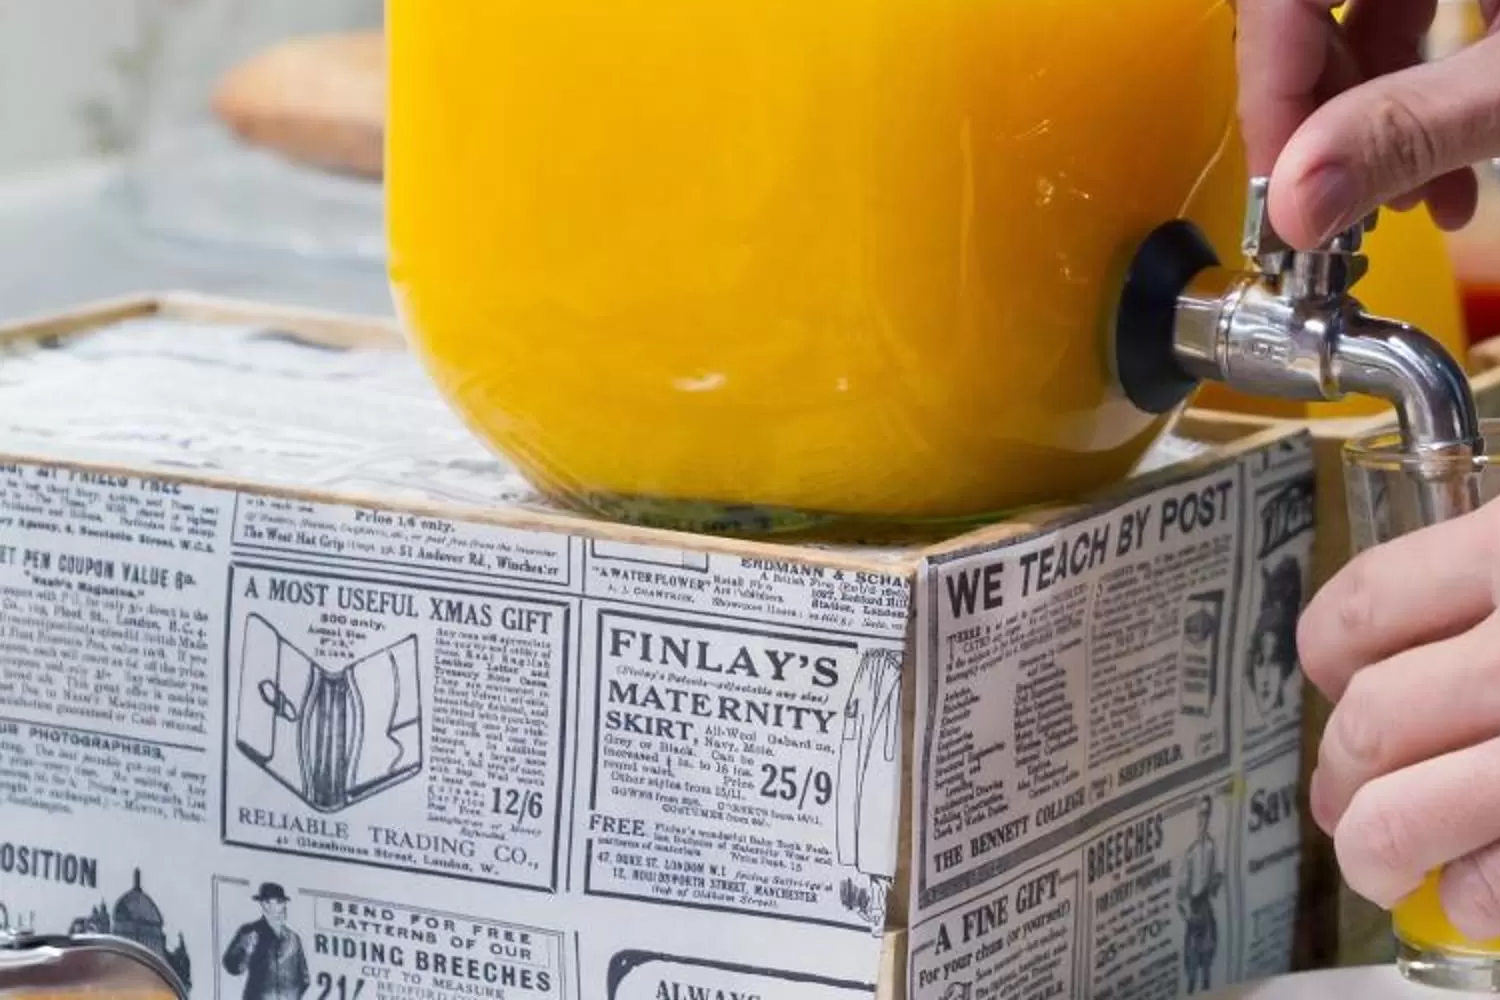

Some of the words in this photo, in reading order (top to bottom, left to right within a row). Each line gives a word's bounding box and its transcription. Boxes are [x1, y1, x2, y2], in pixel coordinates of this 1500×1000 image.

[356, 510, 393, 526] Price
[244, 524, 264, 541] The
[266, 527, 293, 544] West
[296, 531, 317, 547] Hat
[319, 534, 345, 554] Grip
[418, 546, 465, 565] Andover
[946, 562, 1004, 619] WE
[1019, 523, 1111, 597] TEACH
[1116, 504, 1152, 556] BY
[1159, 480, 1233, 541] POST
[24, 547, 51, 571] PEN
[58, 553, 115, 580] COUPON
[121, 562, 168, 588] VALUE
[610, 567, 653, 584] WATER
[741, 555, 825, 579] ERDMANN
[833, 569, 845, 582] &
[244, 574, 260, 600] A
[268, 576, 331, 609] MOST
[337, 585, 420, 620] USEFUL
[428, 596, 493, 629] XMAS
[501, 605, 553, 637] GIFT
[608, 627, 839, 690] FINLAY'S
[608, 679, 837, 735] MATERNITY
[29, 725, 165, 761] PHOTOGRAPHERS,
[604, 709, 699, 746] SKIRT,
[604, 732, 632, 749] Grey
[711, 749, 735, 763] Can
[704, 723, 757, 742] All-Wool
[704, 736, 739, 753] Navy,
[699, 760, 711, 771] to
[491, 786, 544, 825] 12/6
[684, 781, 713, 795] from
[759, 763, 833, 811] 25/9
[239, 806, 349, 840] RELIABLE
[367, 825, 475, 858] TRADING
[493, 843, 539, 871] CO.,
[588, 813, 646, 839] FREE
[933, 844, 963, 873] THE
[970, 814, 1030, 858] BENNETT
[1035, 786, 1086, 827] COLLEGE
[0, 842, 98, 889] OSITION
[296, 835, 369, 856] Glasshouse
[373, 847, 417, 865] Street,
[423, 854, 473, 872] London,
[480, 862, 500, 876] W.
[663, 858, 706, 876] LONDON
[1087, 812, 1165, 885] BREECHES
[753, 883, 818, 905] MANCHESTER
[934, 922, 952, 956] A
[962, 894, 1009, 944] FINE
[1015, 868, 1061, 915] GIFT
[332, 901, 395, 922] SEND
[410, 913, 455, 932] FOR
[472, 922, 531, 945] FREE
[332, 915, 438, 945] PATTERNS
[450, 935, 476, 952] OF
[489, 942, 531, 961] OUR
[314, 932, 403, 967] RIDING
[415, 950, 551, 993] BREECHES
[361, 964, 391, 981] CUT
[401, 971, 422, 986] TO
[432, 976, 505, 1000] MEASURE
[919, 967, 941, 989] For
[943, 953, 974, 982] your
